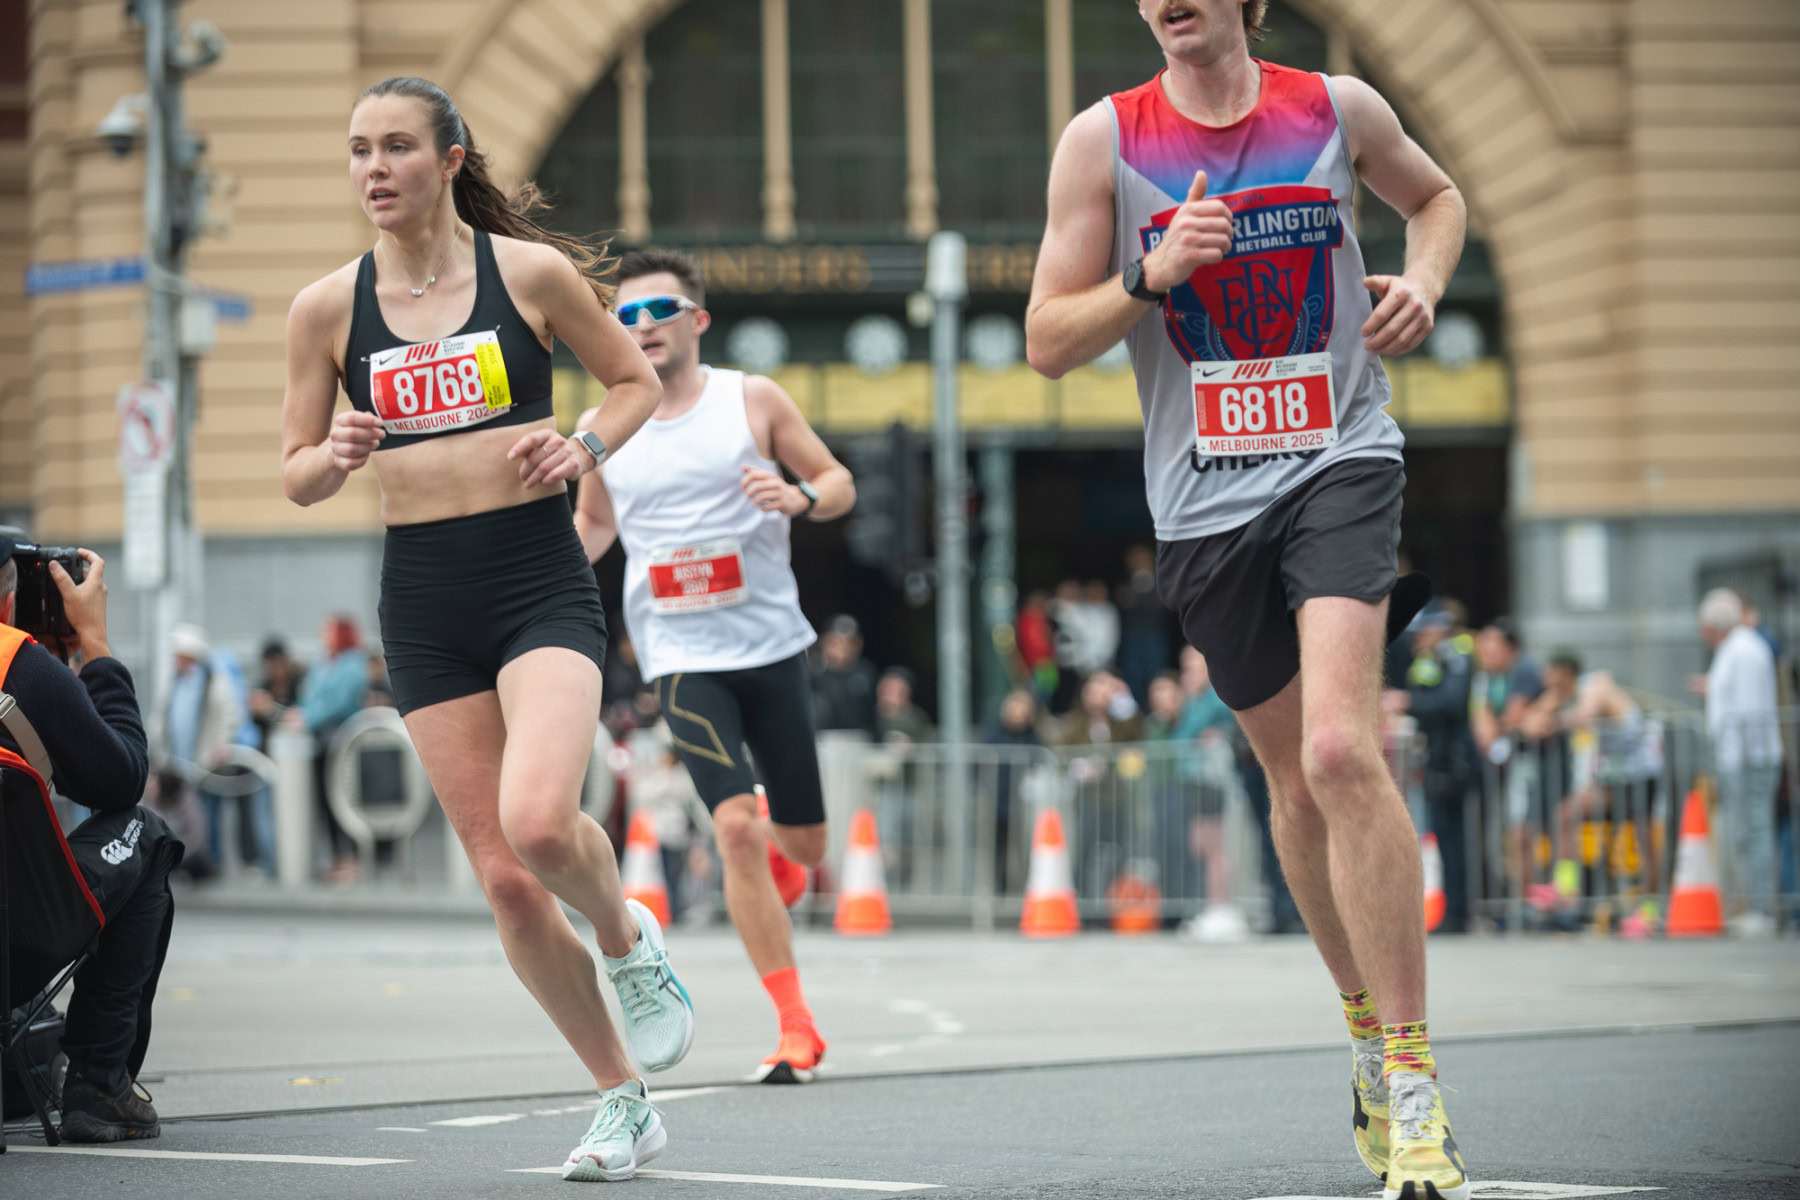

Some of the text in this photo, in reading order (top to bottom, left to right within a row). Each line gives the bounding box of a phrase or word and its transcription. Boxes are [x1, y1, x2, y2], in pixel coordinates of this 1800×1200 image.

[1149, 206, 1337, 250] PRLINGTON
[1236, 230, 1327, 253] NETBALL CLUB
[393, 358, 483, 415] 8768
[394, 412, 463, 431] MELBOURNE
[1219, 382, 1309, 433] 6818
[1209, 432, 1324, 452] MELBOURNE 2025
